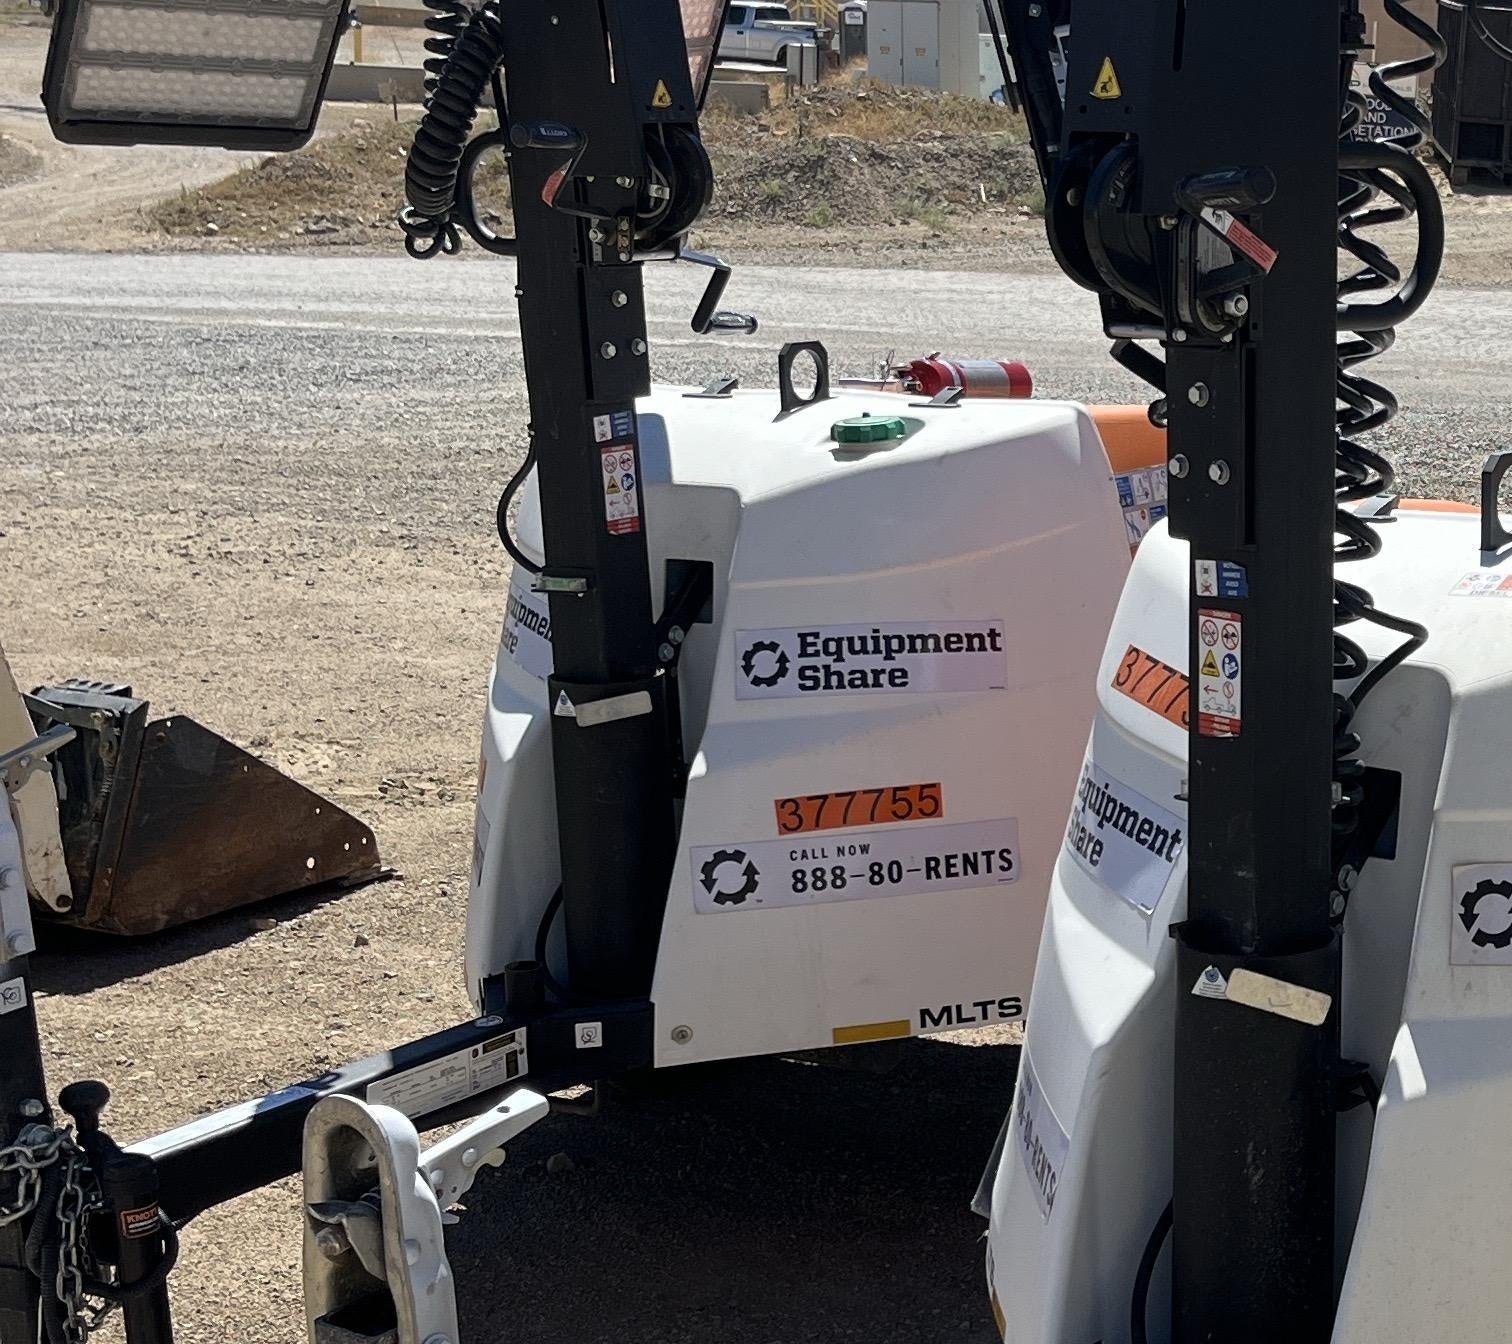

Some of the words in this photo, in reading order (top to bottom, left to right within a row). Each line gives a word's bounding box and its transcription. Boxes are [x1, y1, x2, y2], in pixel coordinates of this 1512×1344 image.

[797, 628, 1002, 663] Equipment
[797, 664, 909, 692] Share
[1115, 646, 1190, 726] 3777
[779, 782, 940, 833] 377755
[789, 847, 829, 862] CALL
[836, 842, 871, 858] NOW
[791, 847, 1014, 894] 888-80-RENTS
[919, 996, 1023, 1029] MLTS
